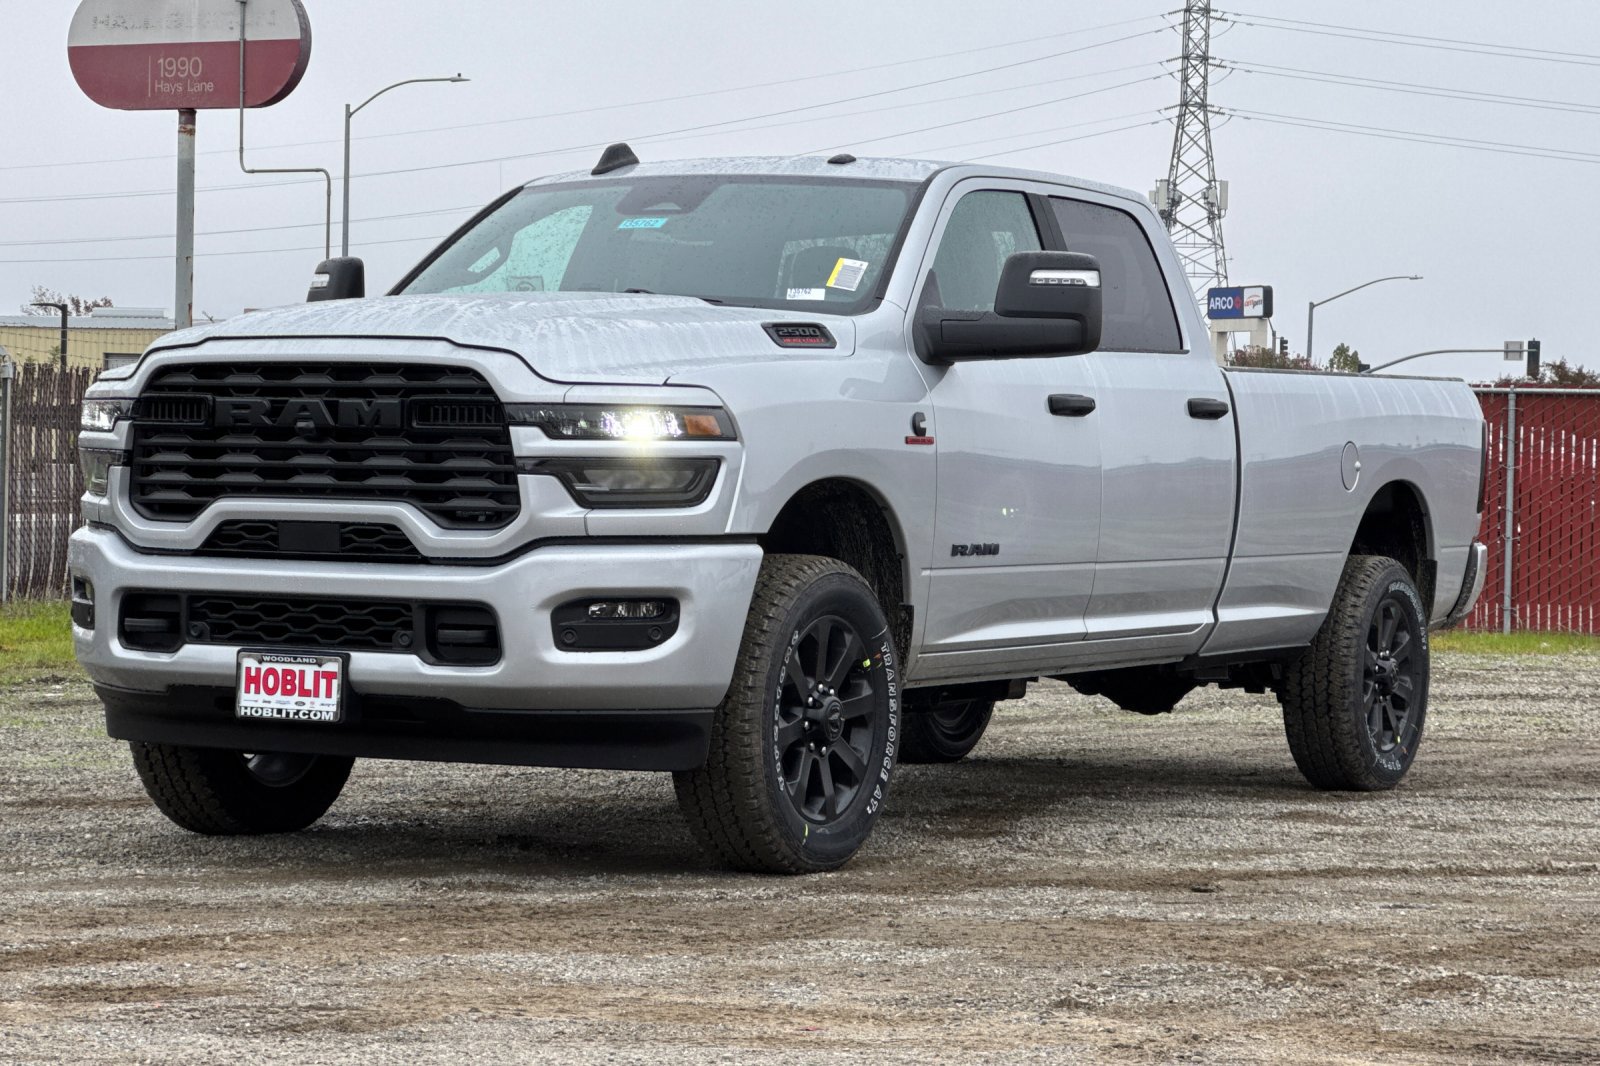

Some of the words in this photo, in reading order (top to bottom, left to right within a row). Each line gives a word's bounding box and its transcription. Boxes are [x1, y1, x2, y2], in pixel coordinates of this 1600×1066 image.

[157, 56, 203, 78] 1990
[154, 79, 183, 93] Hays
[187, 79, 214, 93] Lane
[1209, 296, 1234, 310] ARCO
[779, 327, 820, 336] 2500
[215, 397, 402, 427] RAM
[951, 543, 1000, 557] RAM
[262, 655, 317, 664] WOODLAND
[244, 666, 338, 699] HOBLIT
[240, 706, 334, 721] HOBLIT.COM
[880, 642, 897, 782] TRANSFORCE
